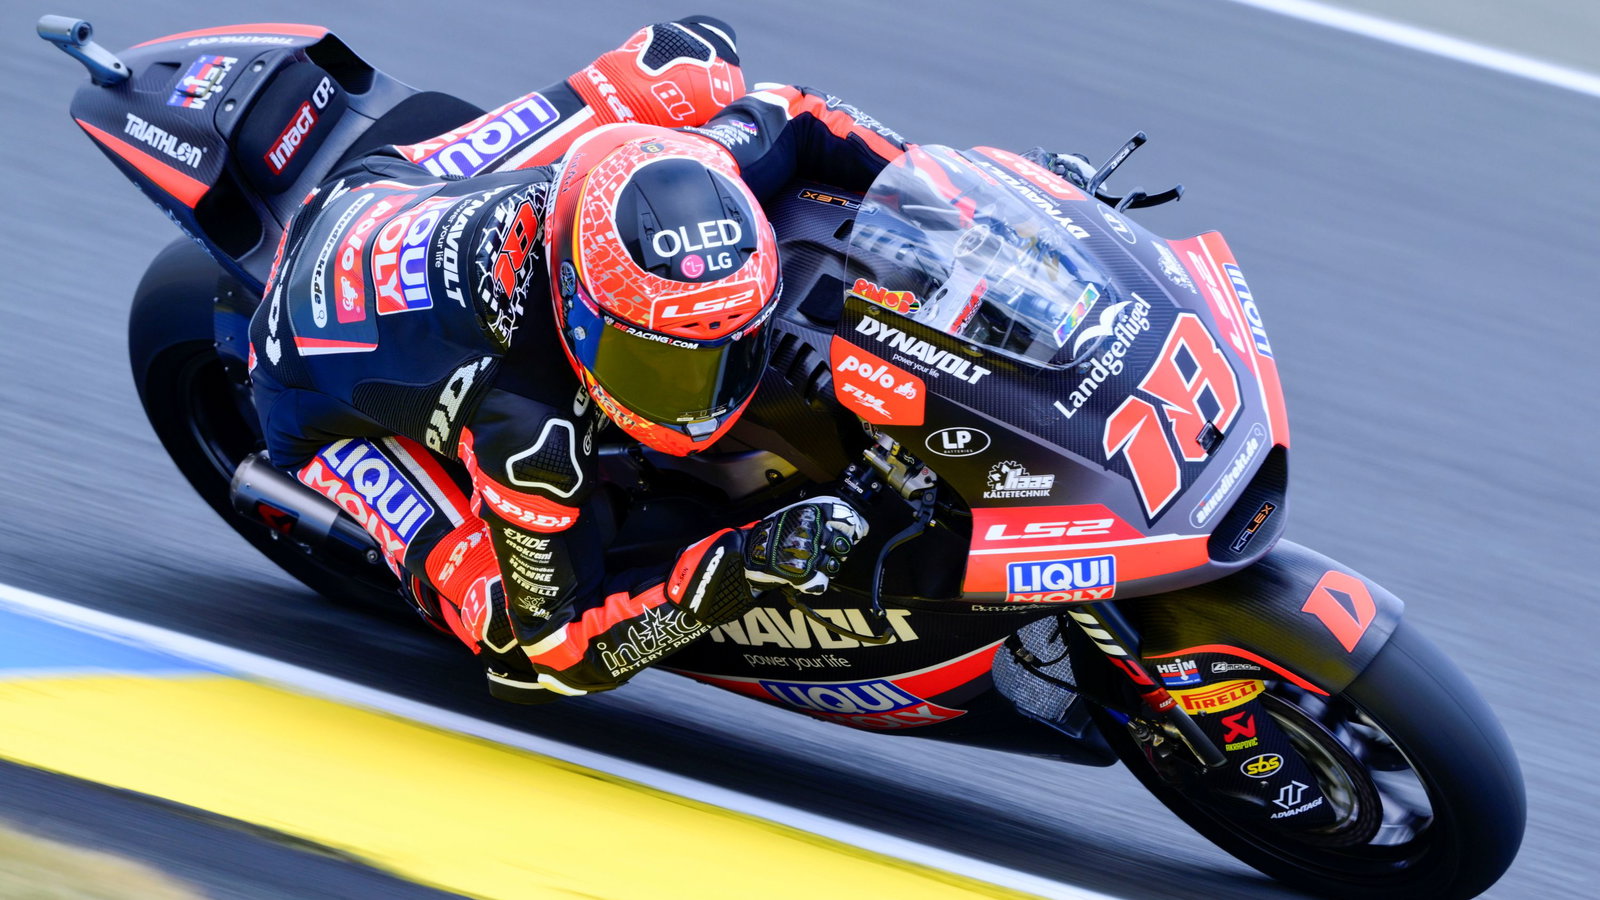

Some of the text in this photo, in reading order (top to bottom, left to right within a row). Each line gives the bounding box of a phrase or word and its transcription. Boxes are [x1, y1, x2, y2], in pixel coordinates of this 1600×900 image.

[124, 113, 203, 169] TRIATHLON
[423, 99, 550, 177] LIQUI
[652, 218, 742, 258] OLED
[706, 252, 733, 271] LG
[662, 289, 754, 318] LS2
[855, 315, 991, 384] DYNAVOLT
[1053, 292, 1152, 420] Landgeflügel
[837, 355, 895, 389] polo
[892, 352, 940, 378] power your life
[1103, 313, 1242, 520] 18
[942, 430, 972, 450] LP
[322, 438, 426, 538] LIQUI
[983, 489, 1051, 499] KÄLTETECHNIK
[303, 461, 404, 553] MOLY
[503, 528, 550, 551] EXIDE
[984, 518, 1115, 541] LS2
[1013, 560, 1110, 593] LIQUI
[1011, 588, 1113, 602] MOLY
[611, 650, 663, 678] BATTERY
[744, 653, 789, 668] power
[789, 655, 826, 671] your
[768, 683, 913, 714] LIQUI
[1181, 680, 1258, 710] PIRELLI
[1247, 754, 1281, 775] sbs
[1270, 796, 1323, 819] ADVANTAGE
